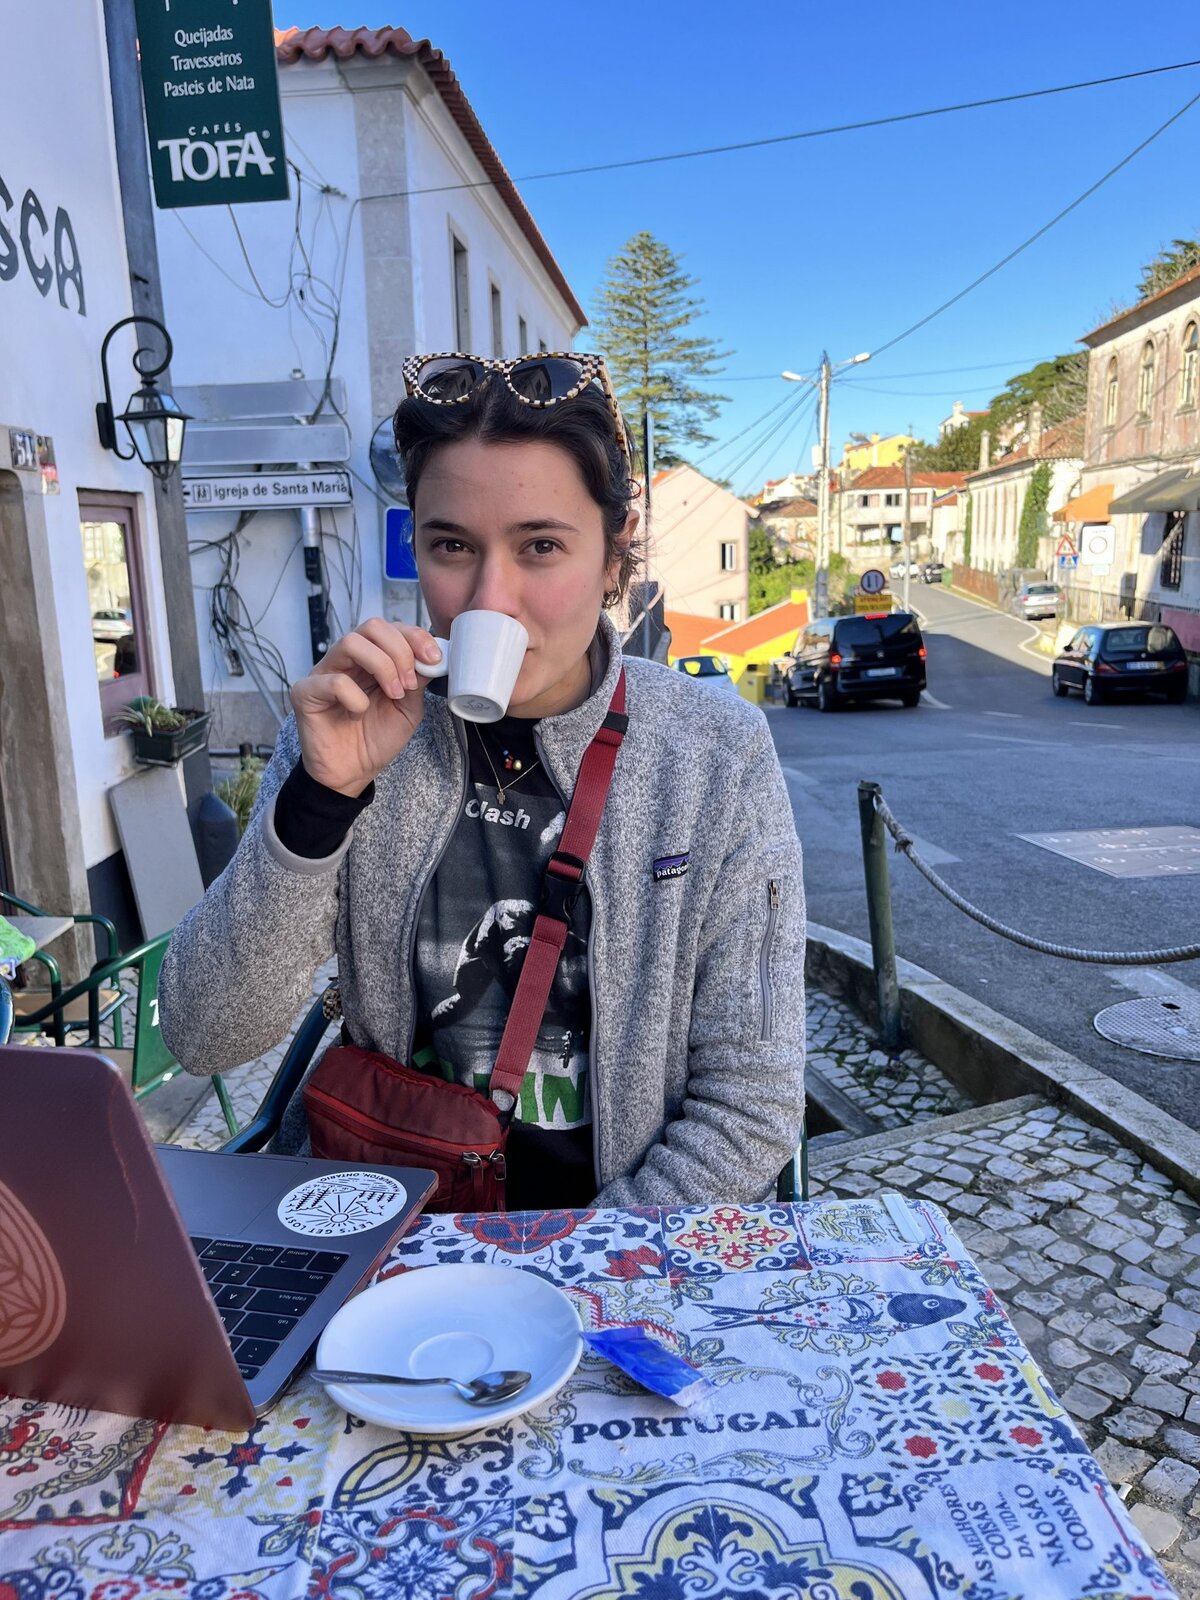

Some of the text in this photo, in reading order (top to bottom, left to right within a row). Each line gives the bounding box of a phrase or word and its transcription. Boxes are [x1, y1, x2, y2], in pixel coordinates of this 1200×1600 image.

[174, 25, 234, 48] Queijadas
[170, 52, 243, 71] Travesseiros
[207, 76, 223, 94] de
[226, 75, 255, 91] Nata
[188, 122, 242, 136] CAFÉS
[157, 131, 276, 181] TOFA
[214, 480, 347, 500] igreja de Santa Maria
[465, 799, 531, 830] Clash
[320, 1172, 360, 1182] ONTARIO
[285, 1216, 307, 1231] LOST
[340, 1221, 374, 1233] LET'S
[571, 1408, 822, 1444] PORTUGAL
[1045, 1485, 1094, 1551] COISAS.
[938, 1483, 997, 1583] AS MELHORES
[966, 1500, 1012, 1560] COISAS
[1013, 1534, 1035, 1558] DA
